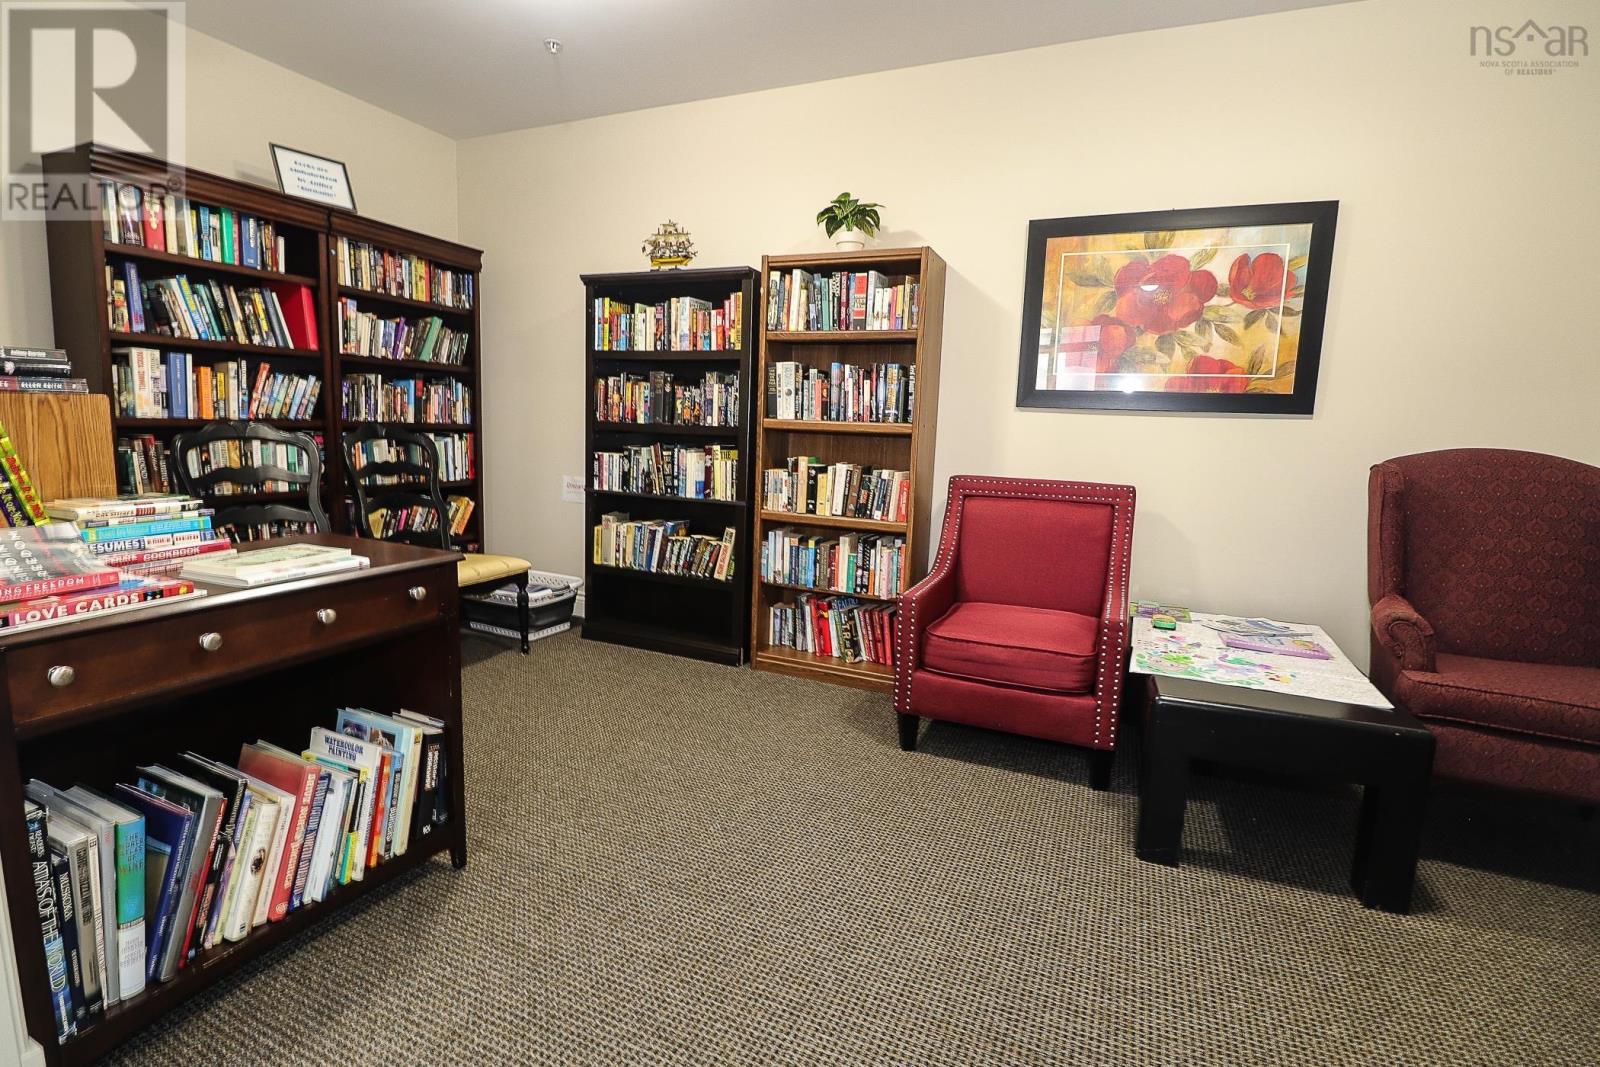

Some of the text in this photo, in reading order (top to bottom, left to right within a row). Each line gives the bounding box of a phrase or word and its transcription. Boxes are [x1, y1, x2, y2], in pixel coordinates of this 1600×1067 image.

[143, 546, 201, 562] COOKBOOK
[26, 577, 85, 593] FREEDOM
[14, 605, 68, 625] LOVE
[75, 592, 140, 614] CARDS
[324, 734, 364, 755] WATERCOLOR
[328, 745, 358, 761] PAINTING
[32, 861, 52, 900] ATLAS
[44, 936, 67, 993] WORLD
